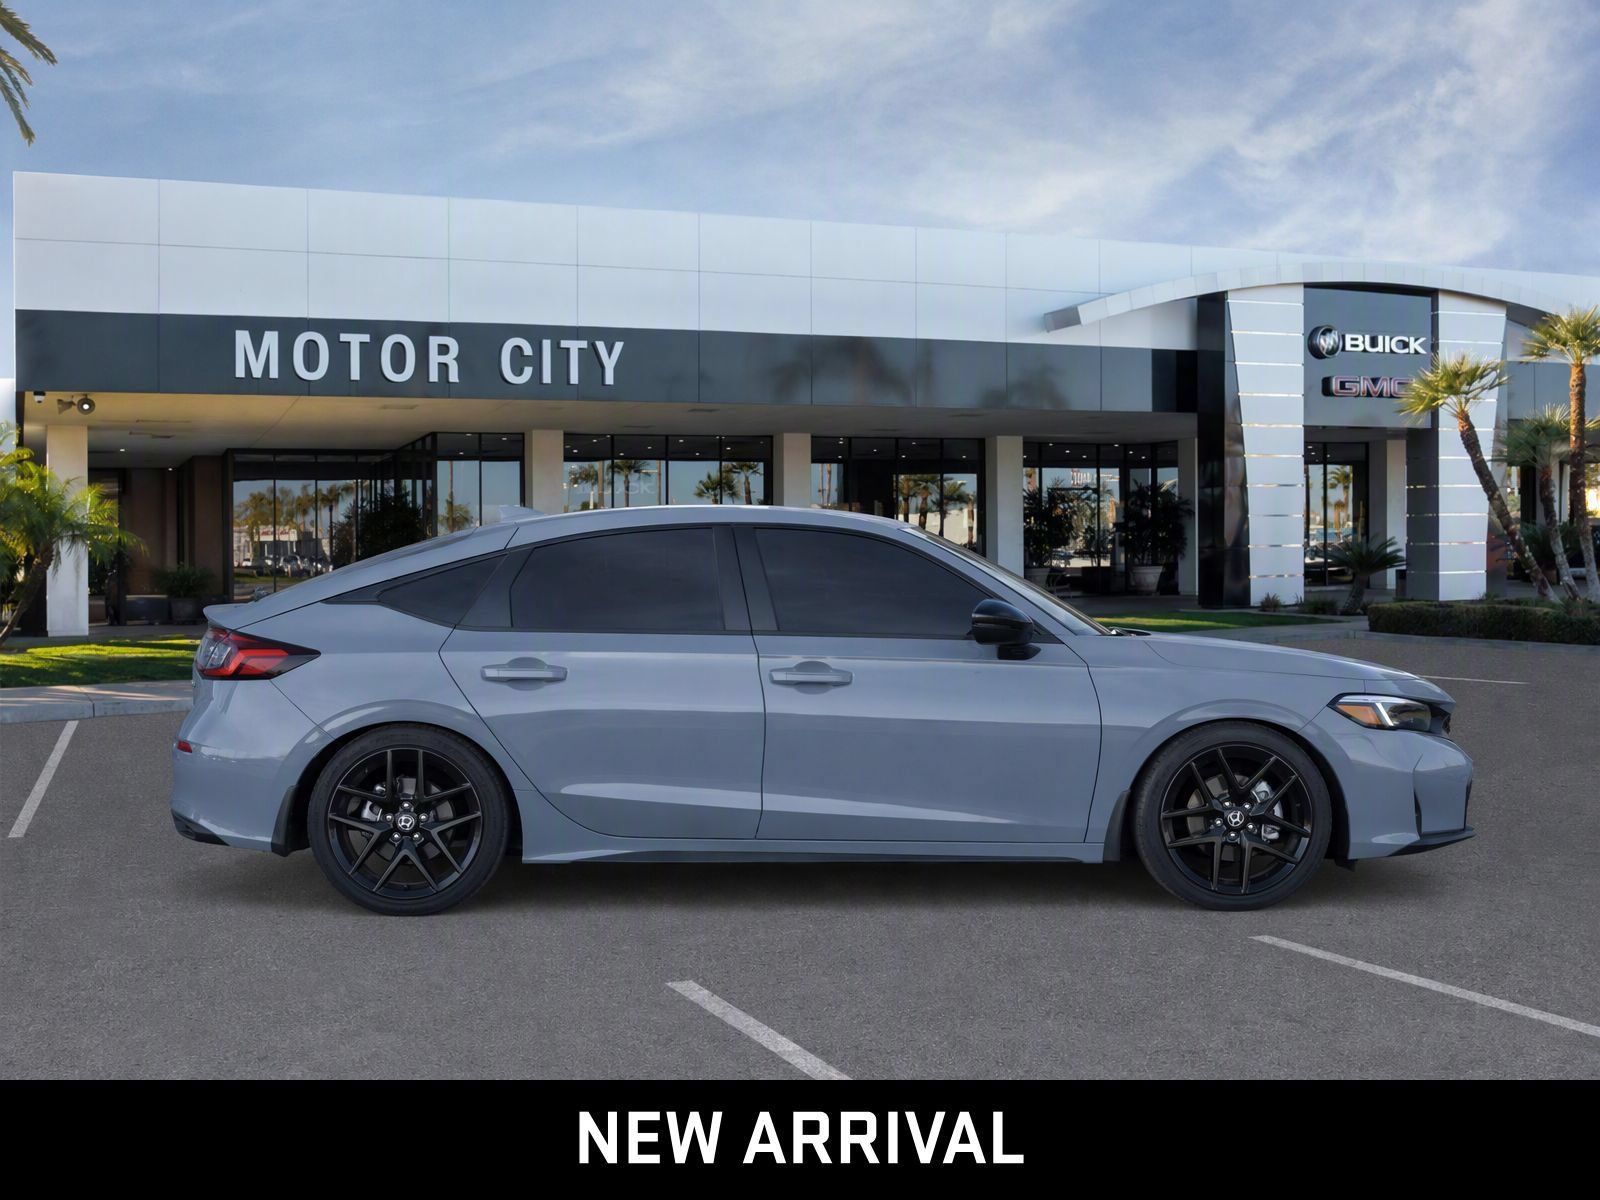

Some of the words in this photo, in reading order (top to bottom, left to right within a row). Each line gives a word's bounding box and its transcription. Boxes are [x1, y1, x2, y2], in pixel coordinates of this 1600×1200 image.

[1344, 333, 1427, 355] BUICK
[234, 329, 460, 383] MOTOR
[501, 337, 624, 386] CITY
[1332, 375, 1415, 398] GMC
